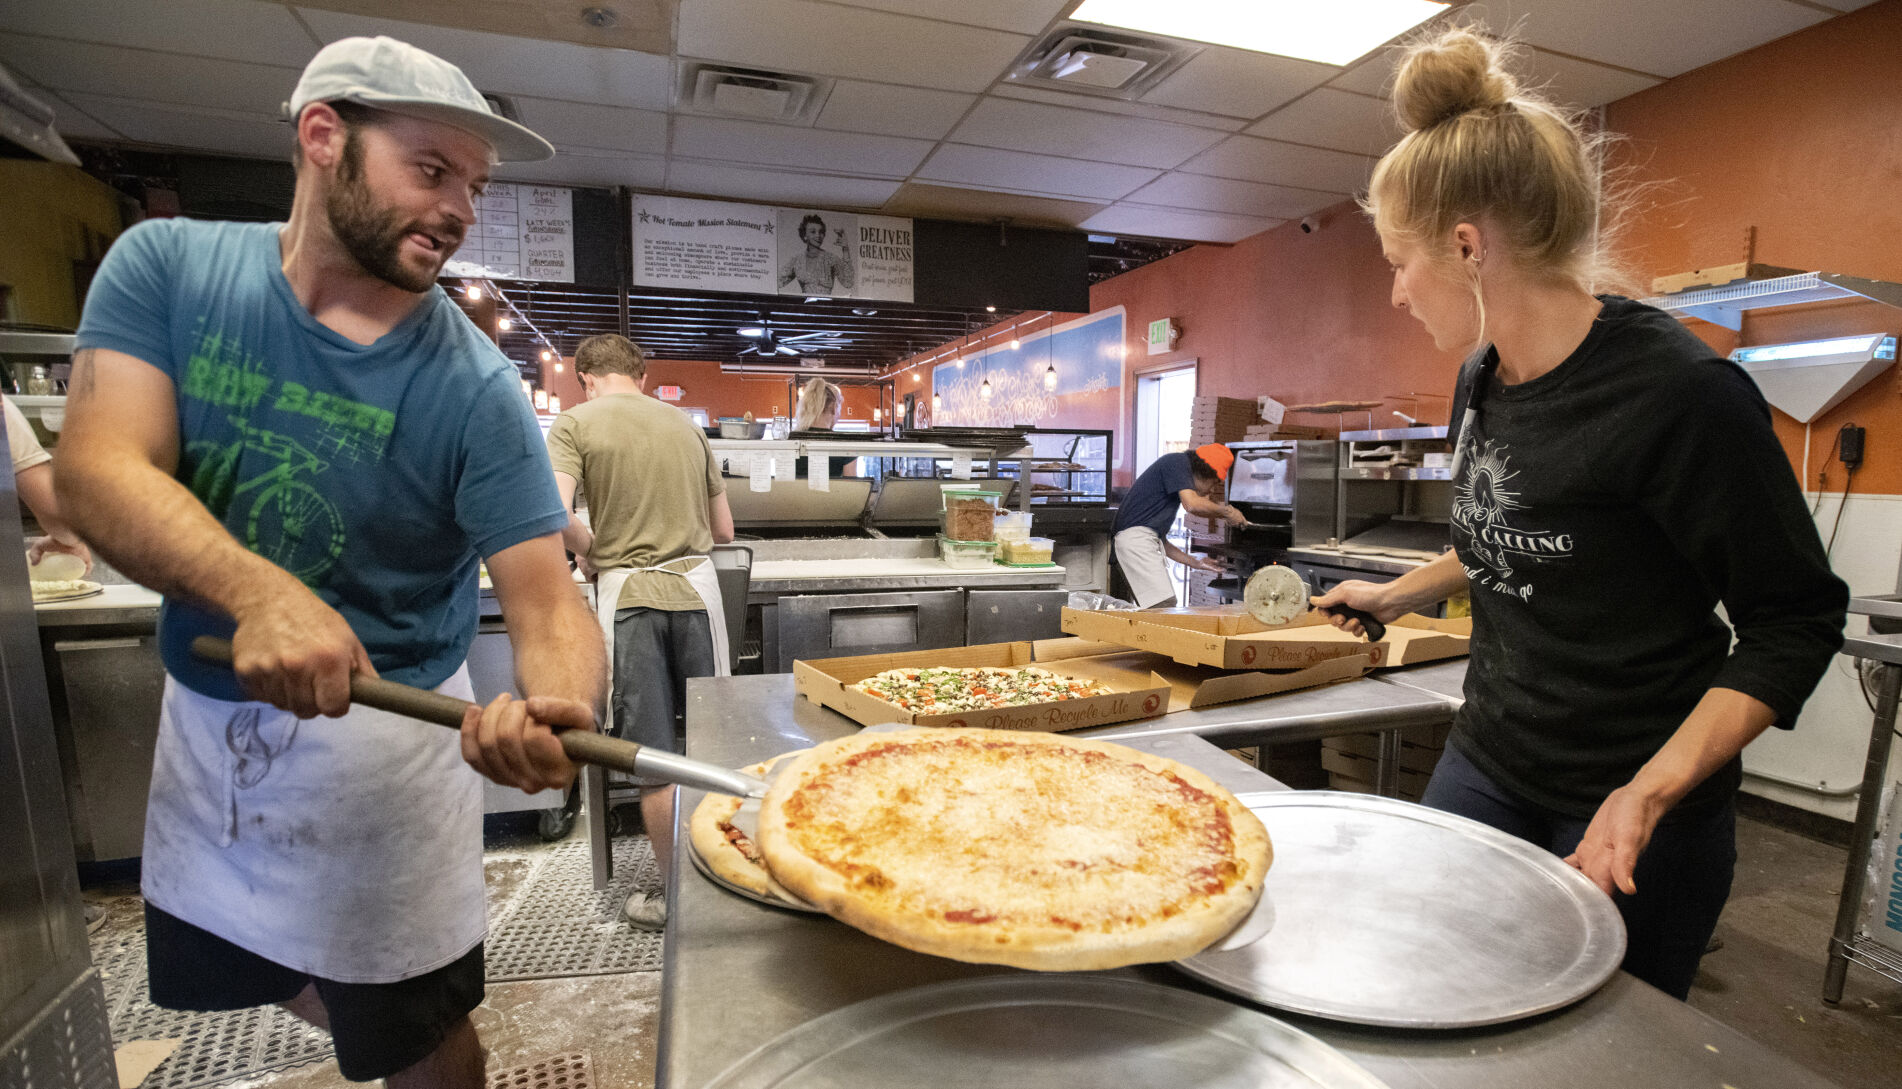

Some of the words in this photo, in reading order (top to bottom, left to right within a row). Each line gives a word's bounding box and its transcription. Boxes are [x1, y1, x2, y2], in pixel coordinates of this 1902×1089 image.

[532, 188, 556, 198] April
[652, 214, 666, 224] Hot
[666, 218, 695, 227] Tomato
[697, 218, 724, 227] Mission
[726, 218, 762, 230] Statement
[860, 227, 910, 246] DELIVER
[859, 244, 912, 262] GREATNESS
[1152, 320, 1167, 344] EXIT
[662, 386, 678, 398] EXIT
[1481, 528, 1574, 552] CALLING
[1460, 562, 1484, 580] nd
[1481, 576, 1492, 584] i
[1268, 646, 1302, 662] Please
[984, 714, 1038, 730] Please
[1042, 704, 1098, 726] Recycle
[1101, 699, 1129, 718] Me
